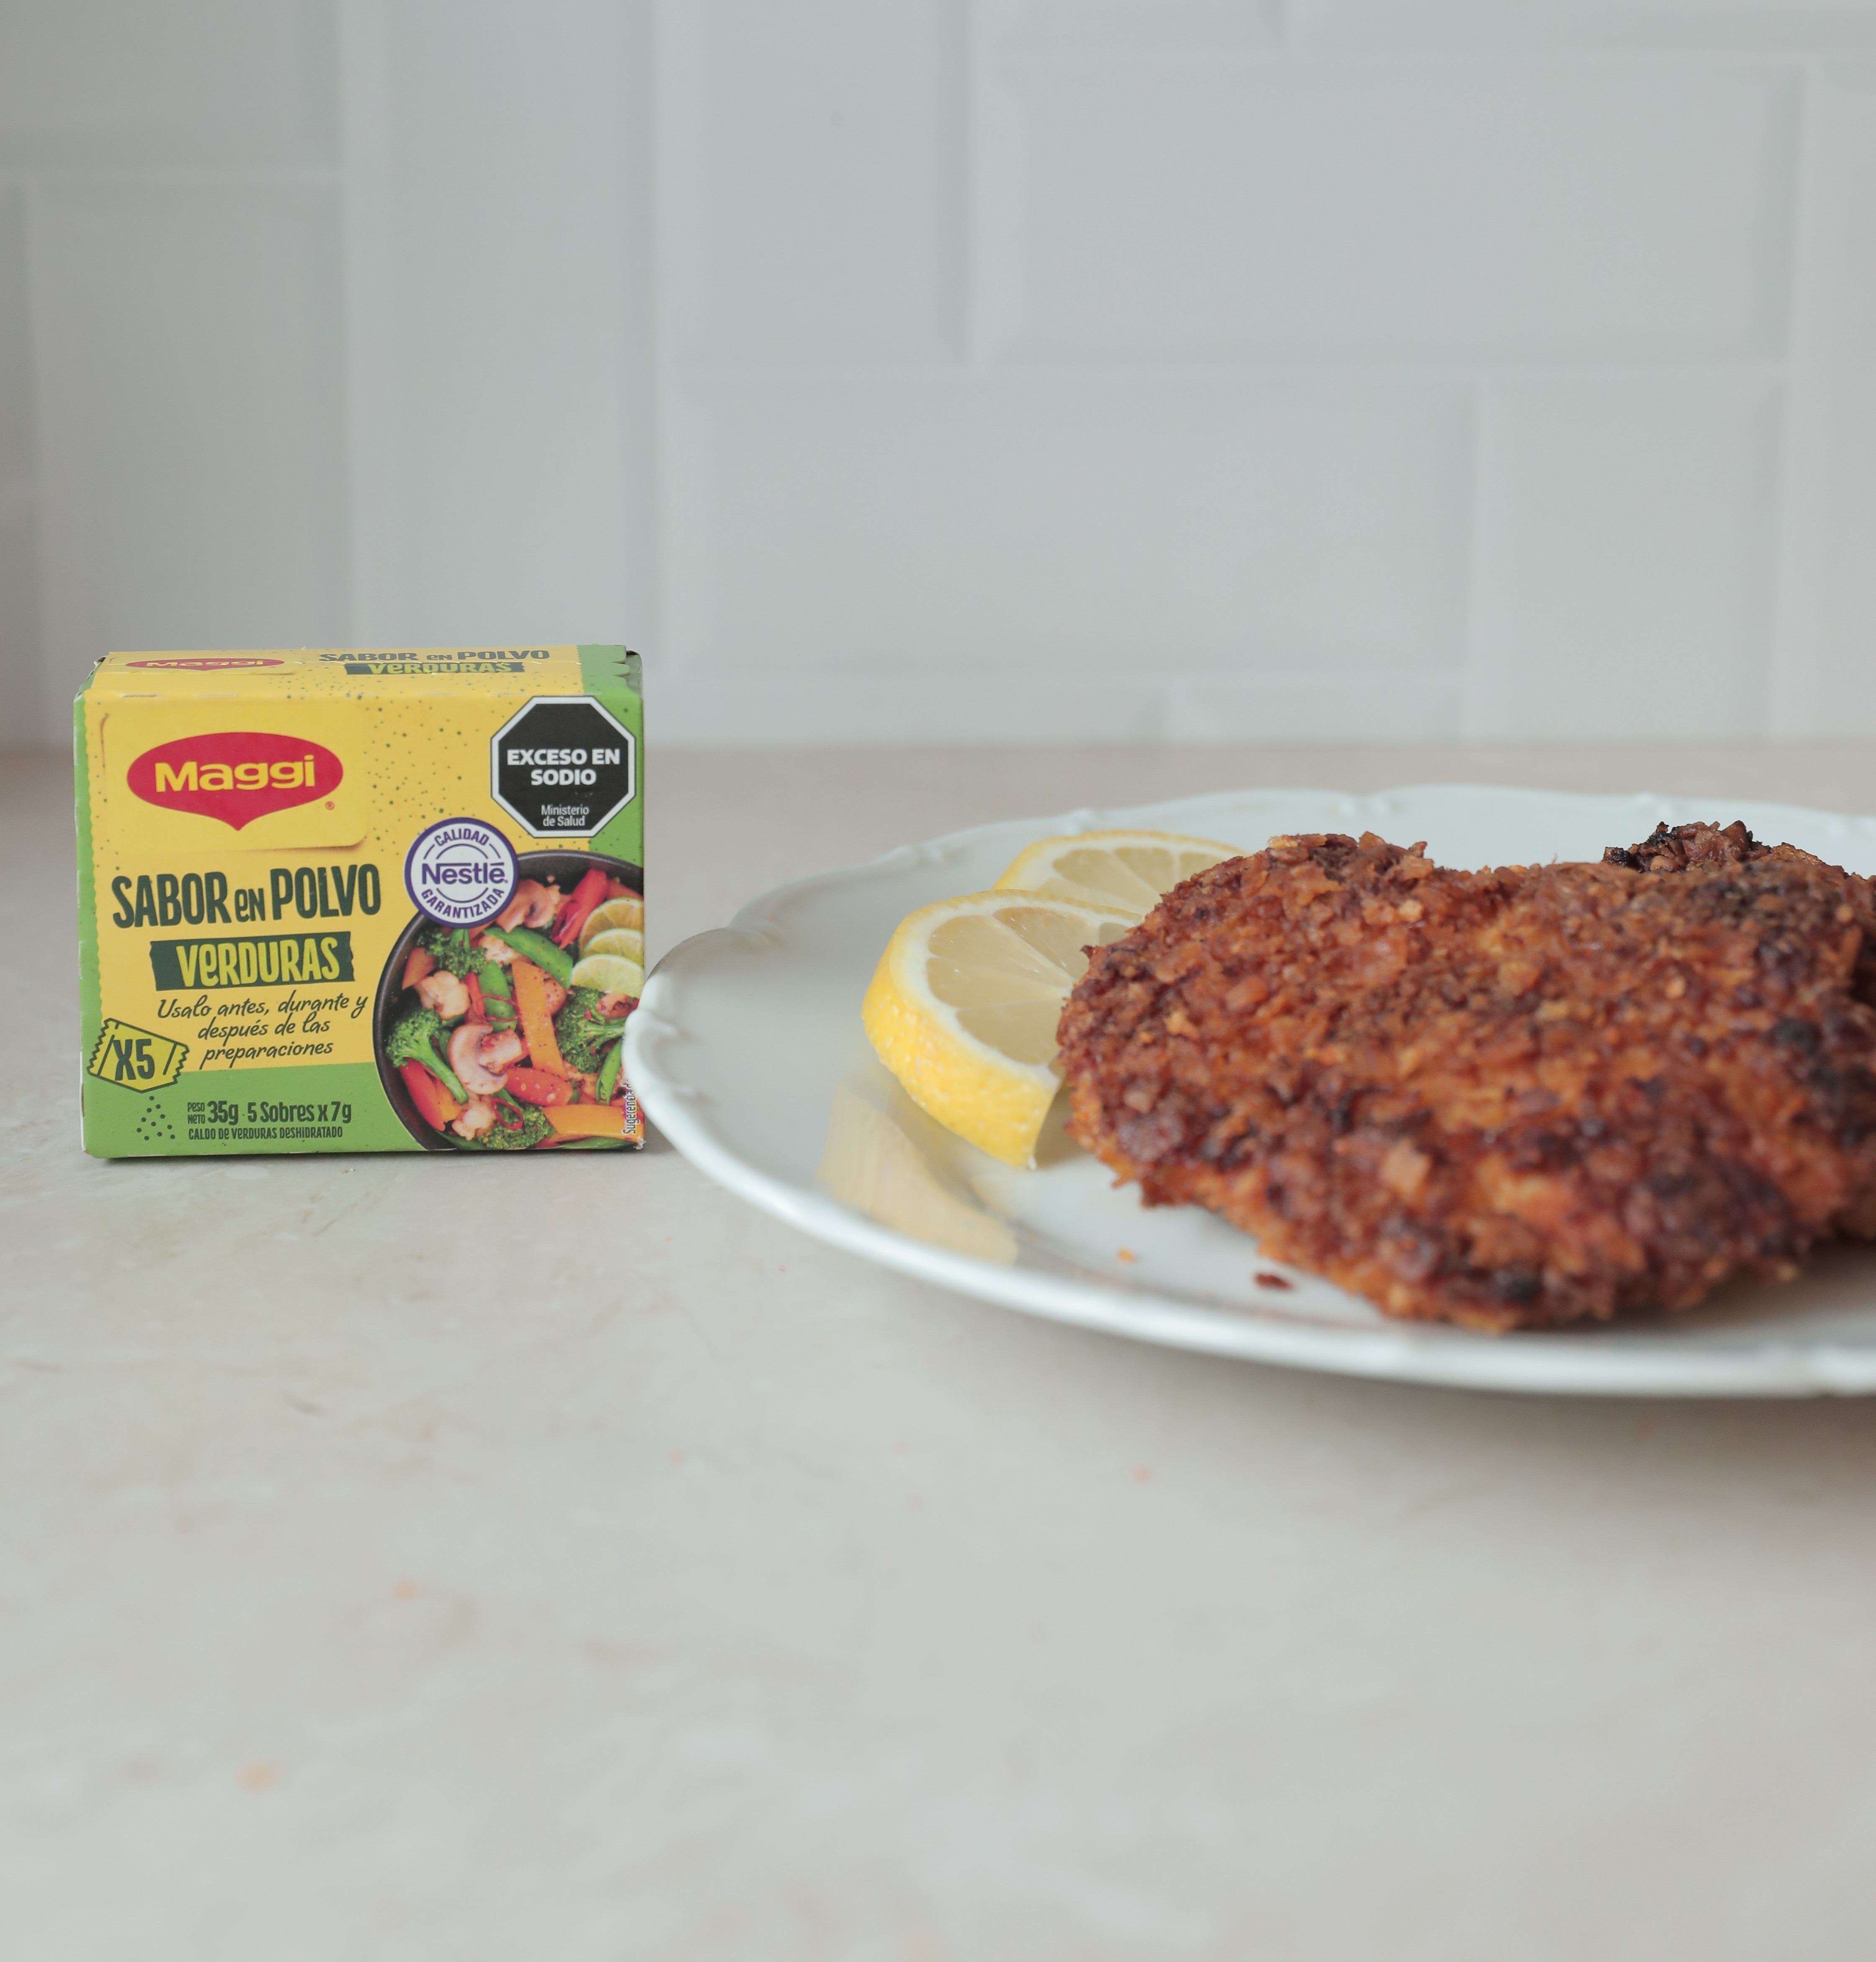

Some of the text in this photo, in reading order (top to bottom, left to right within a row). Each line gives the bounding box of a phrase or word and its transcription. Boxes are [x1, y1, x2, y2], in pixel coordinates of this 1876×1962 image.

[319, 652, 417, 661] SABOR
[457, 650, 550, 659] POLVO
[507, 748, 620, 765] EXCESO EN
[155, 754, 315, 792] Maggi
[531, 769, 597, 785] SODIO
[541, 804, 590, 815] Ministerio
[543, 816, 585, 826] de Salud
[434, 828, 489, 846] CALIDAD
[111, 872, 231, 929] SABOR
[270, 864, 381, 920] POLVO
[421, 888, 504, 919] GARANTIZADA
[157, 990, 368, 1019] Usalo antes, durante y
[198, 1011, 331, 1046] después de las
[114, 1038, 155, 1081] X5
[199, 1041, 333, 1070] preparaciones
[207, 1100, 239, 1125] 35g
[247, 1102, 257, 1123] 5
[260, 1101, 314, 1123] Sobres
[188, 1128, 215, 1140] CALDO
